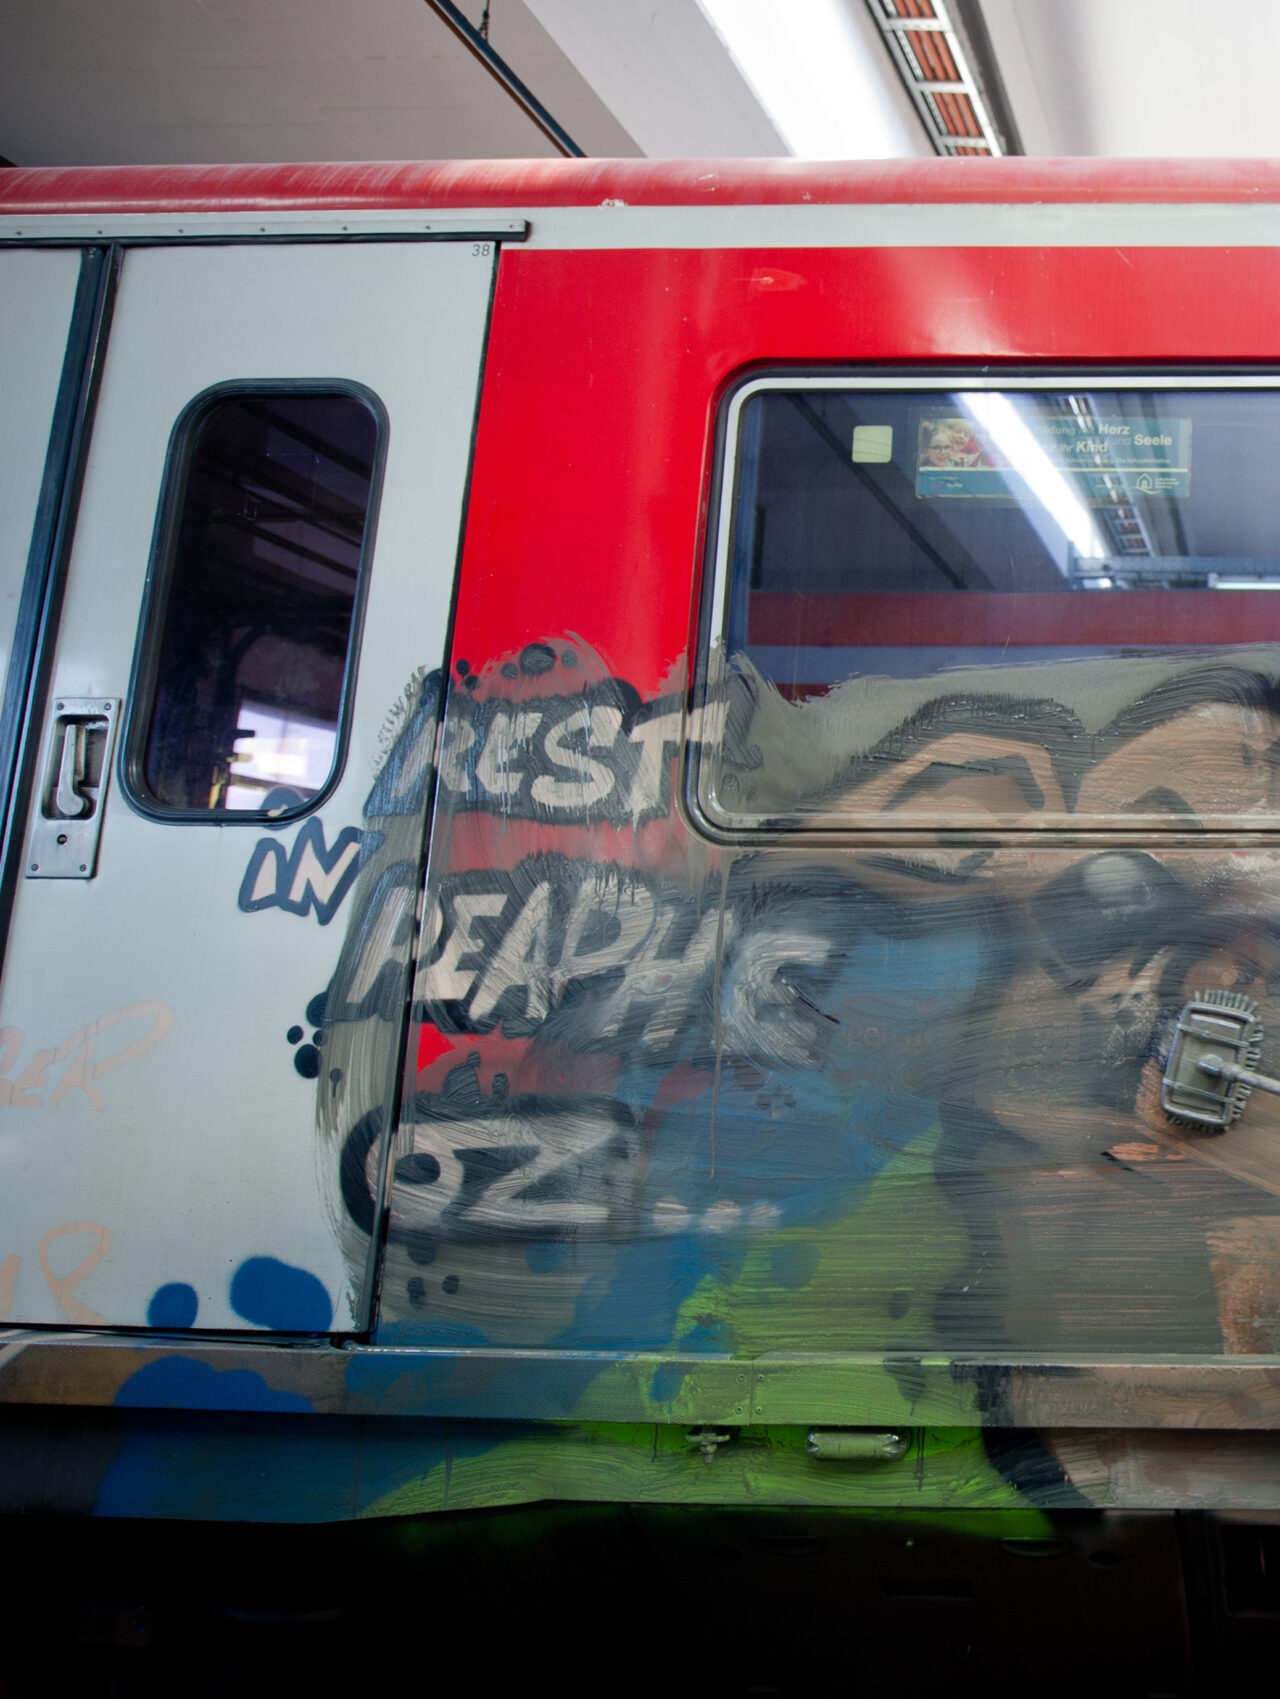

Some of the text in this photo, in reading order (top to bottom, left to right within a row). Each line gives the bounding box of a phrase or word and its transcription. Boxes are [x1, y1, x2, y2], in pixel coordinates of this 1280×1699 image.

[471, 243, 490, 257] 38
[1097, 423, 1131, 435] Herz
[1076, 440, 1108, 453] Kind
[1133, 433, 1173, 447] Seele
